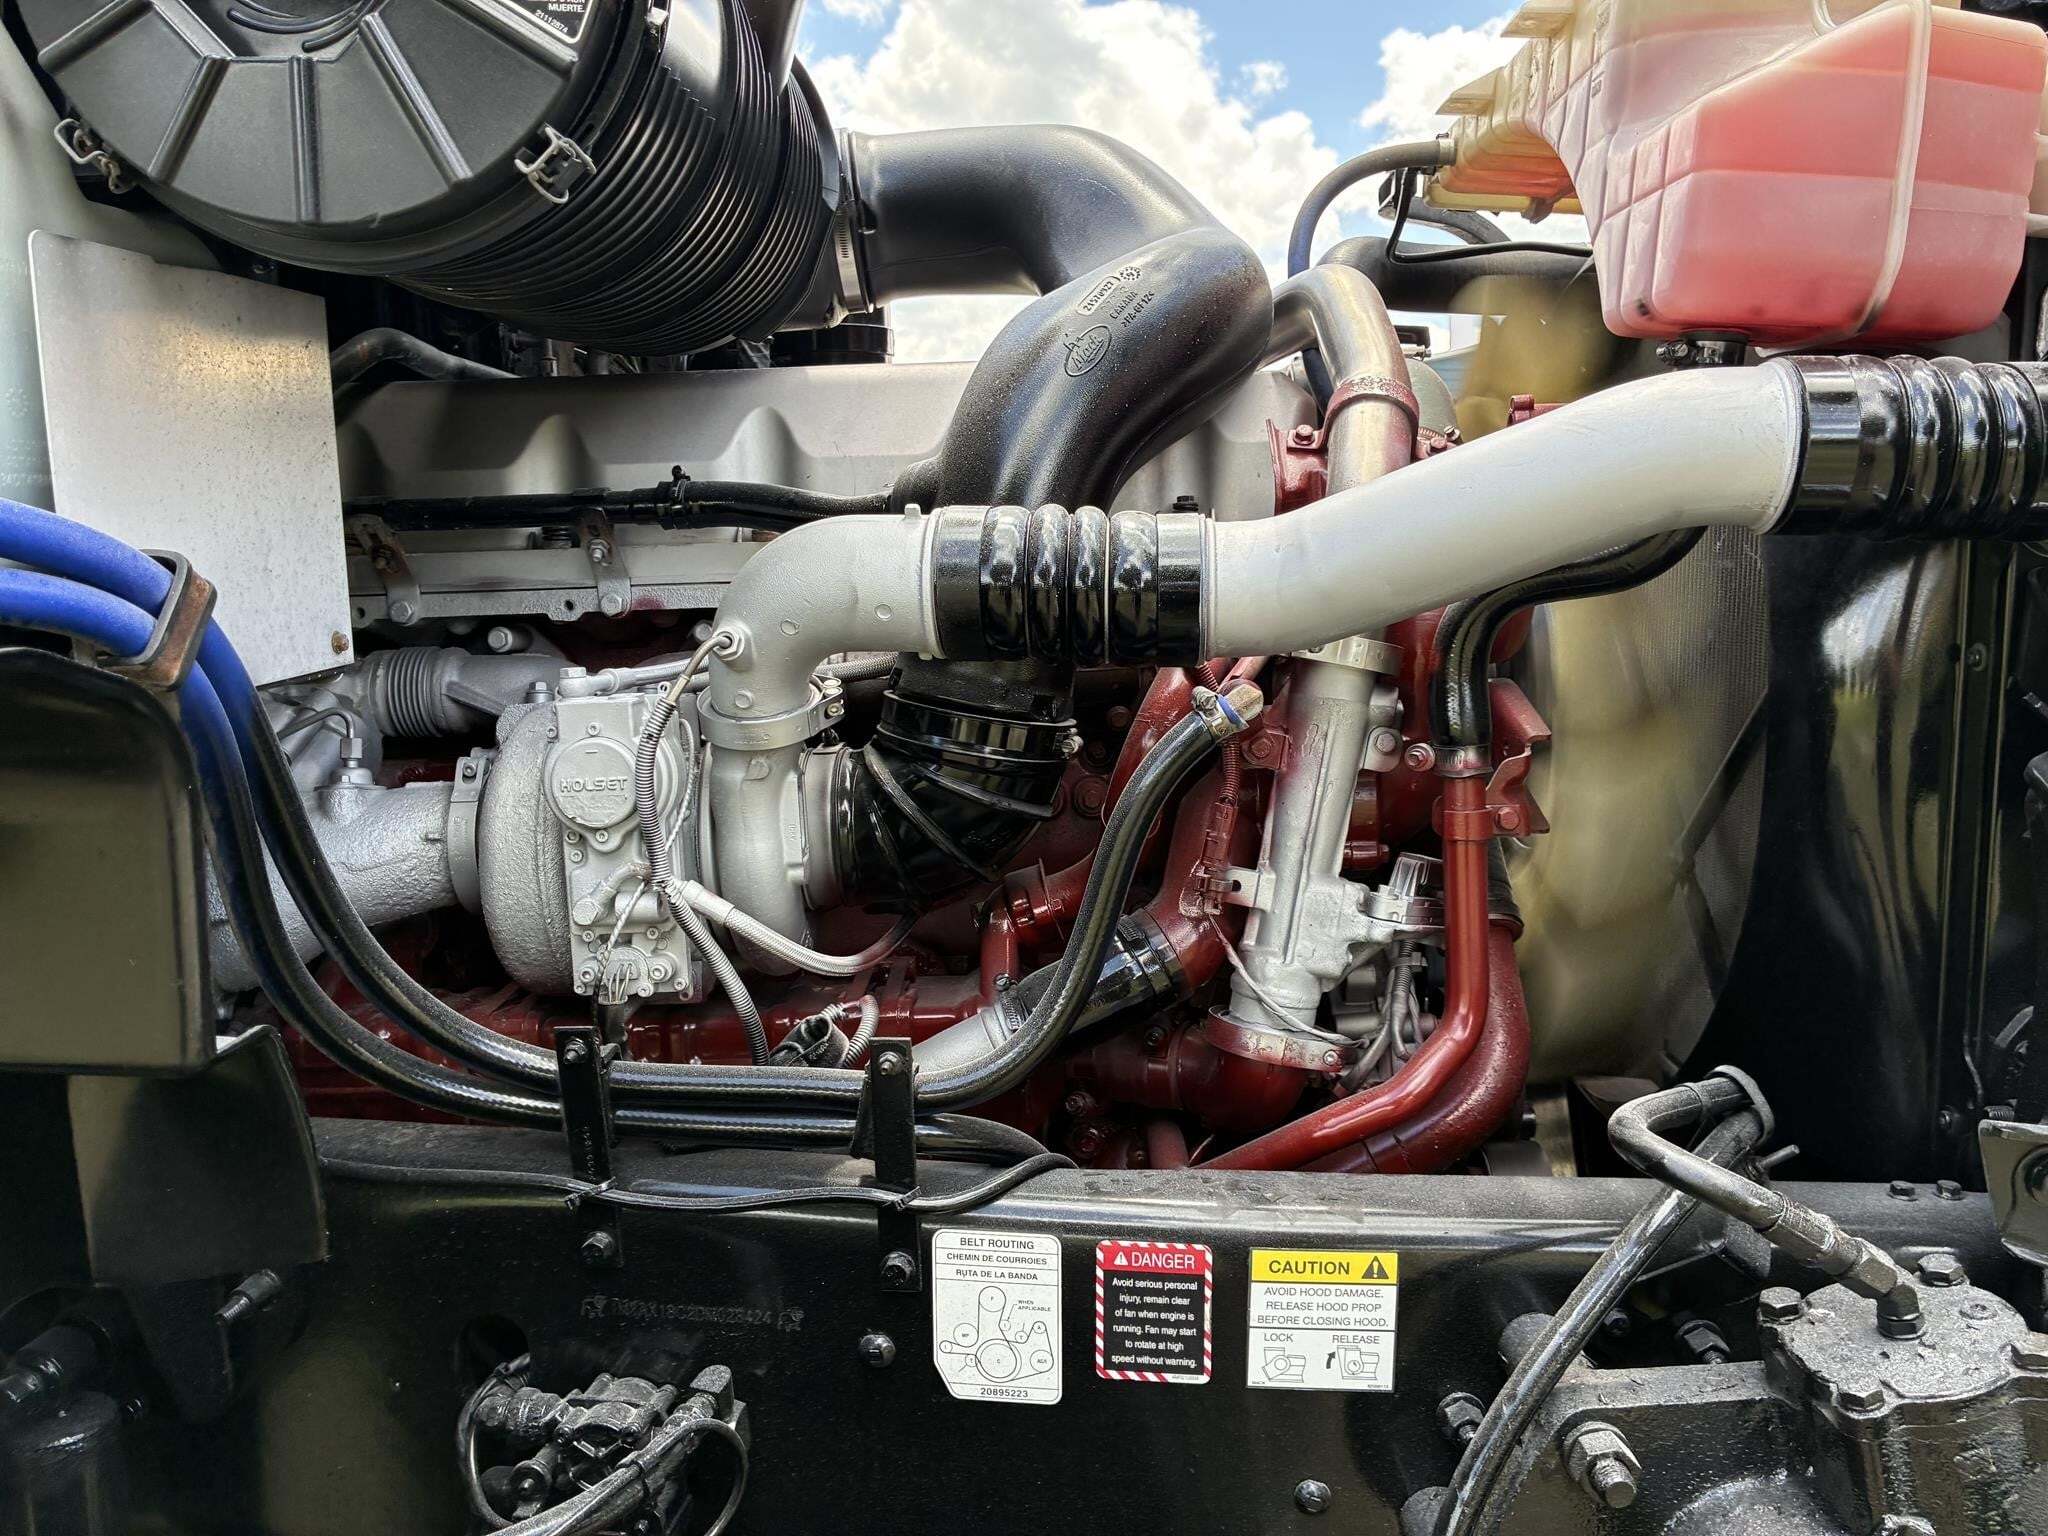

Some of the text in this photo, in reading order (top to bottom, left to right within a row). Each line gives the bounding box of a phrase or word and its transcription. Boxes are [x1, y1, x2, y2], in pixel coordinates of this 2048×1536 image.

[560, 776, 628, 793] HOLSET
[960, 1237, 1035, 1250] BELT ROUTING
[946, 1253, 1047, 1265] CHEMIN DE COURROIES
[1131, 1252, 1195, 1269] DANGER
[1269, 1260, 1350, 1275] CAUTION
[956, 1269, 1038, 1281] RUTA DE LA BANDA
[1112, 1277, 1198, 1291] Avoid serious personal
[1119, 1293, 1191, 1305] injury, remain clear
[1264, 1287, 1384, 1298] AVOID HOOD DAMAGE.
[1266, 1301, 1382, 1312] RELEASE HOOD PROP
[1114, 1308, 1195, 1322] of fan when engine is
[1257, 1315, 1389, 1327] BEFORE CLOSING HOOD.
[1113, 1324, 1197, 1337] running. Fan may start
[1125, 1339, 1184, 1352] to rotate at high
[1264, 1333, 1381, 1345] LOCK RELEASE
[1111, 1354, 1197, 1368] speed without warning.
[980, 1387, 1029, 1398] 20895223
